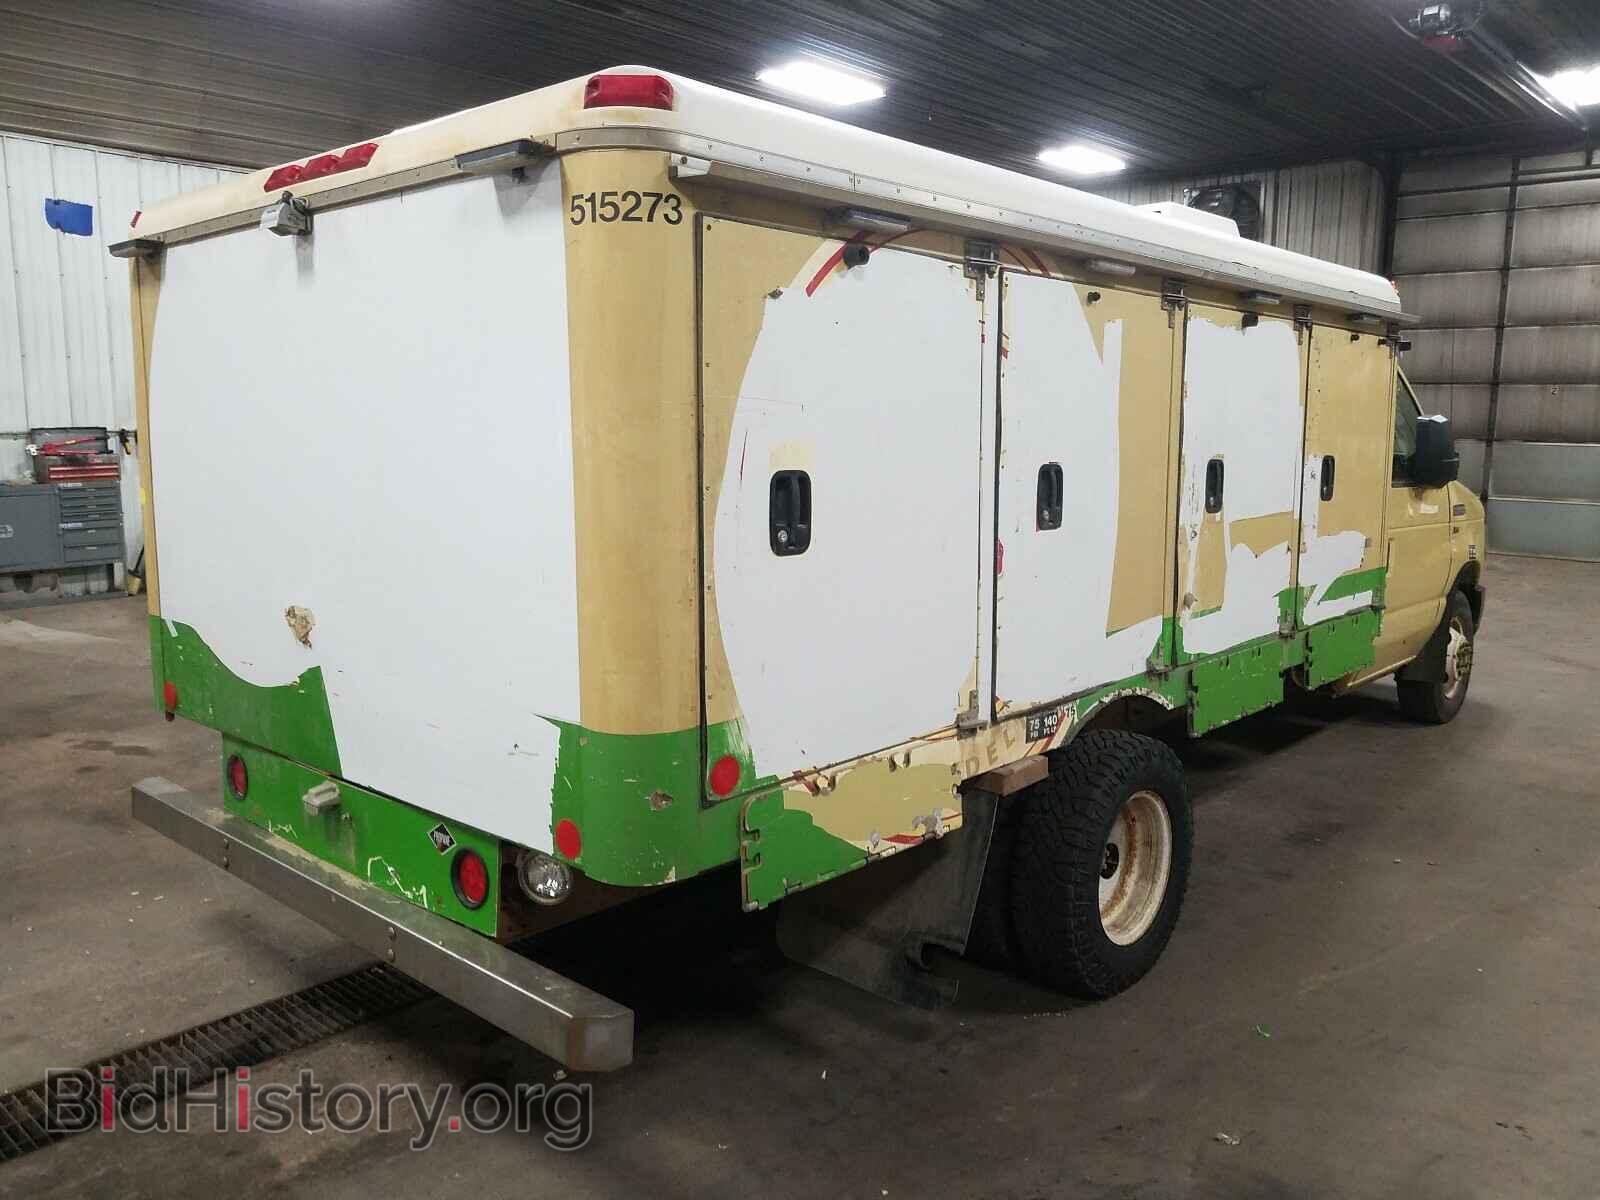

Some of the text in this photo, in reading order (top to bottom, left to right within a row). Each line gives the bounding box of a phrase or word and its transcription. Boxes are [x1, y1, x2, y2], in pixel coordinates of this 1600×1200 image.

[570, 190, 682, 225] 515273
[1029, 714, 1057, 731] 75 140
